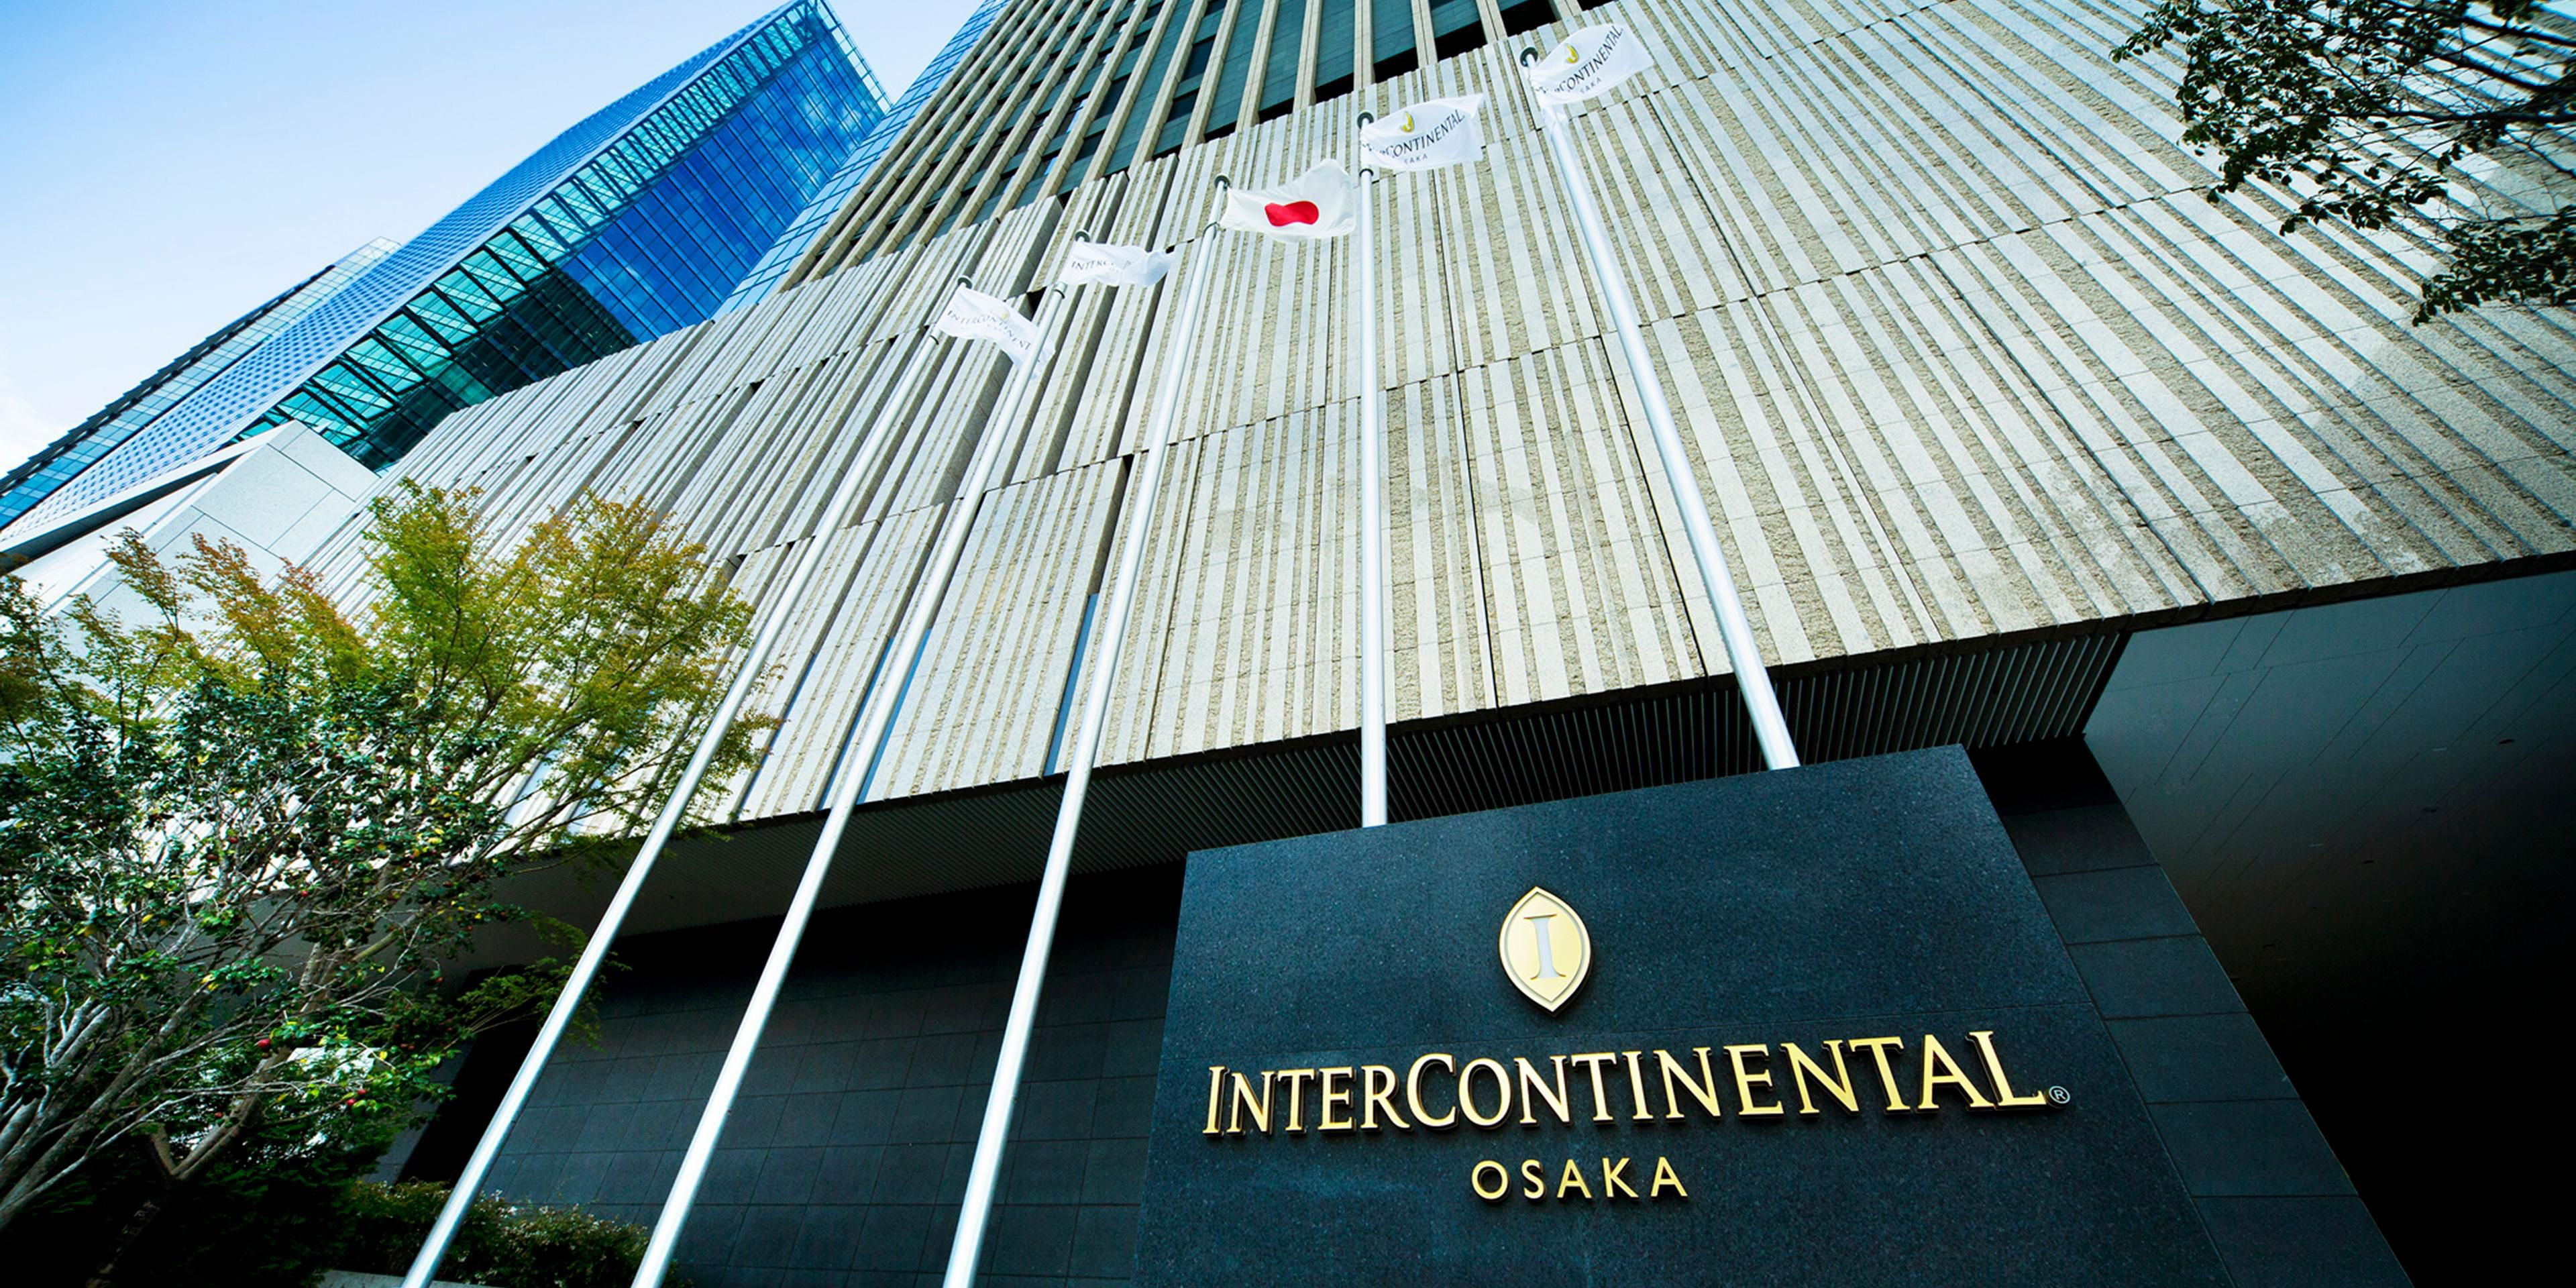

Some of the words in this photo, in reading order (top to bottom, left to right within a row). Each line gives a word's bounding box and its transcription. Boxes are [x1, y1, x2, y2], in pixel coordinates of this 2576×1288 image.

[1535, 25, 1623, 93] CONTINENTAL
[1580, 76, 1602, 94] AKA
[1362, 109, 1465, 158] CONTINENTAL
[1403, 153, 1428, 164] AKA
[1471, 1156, 1689, 1201] OSAKA
